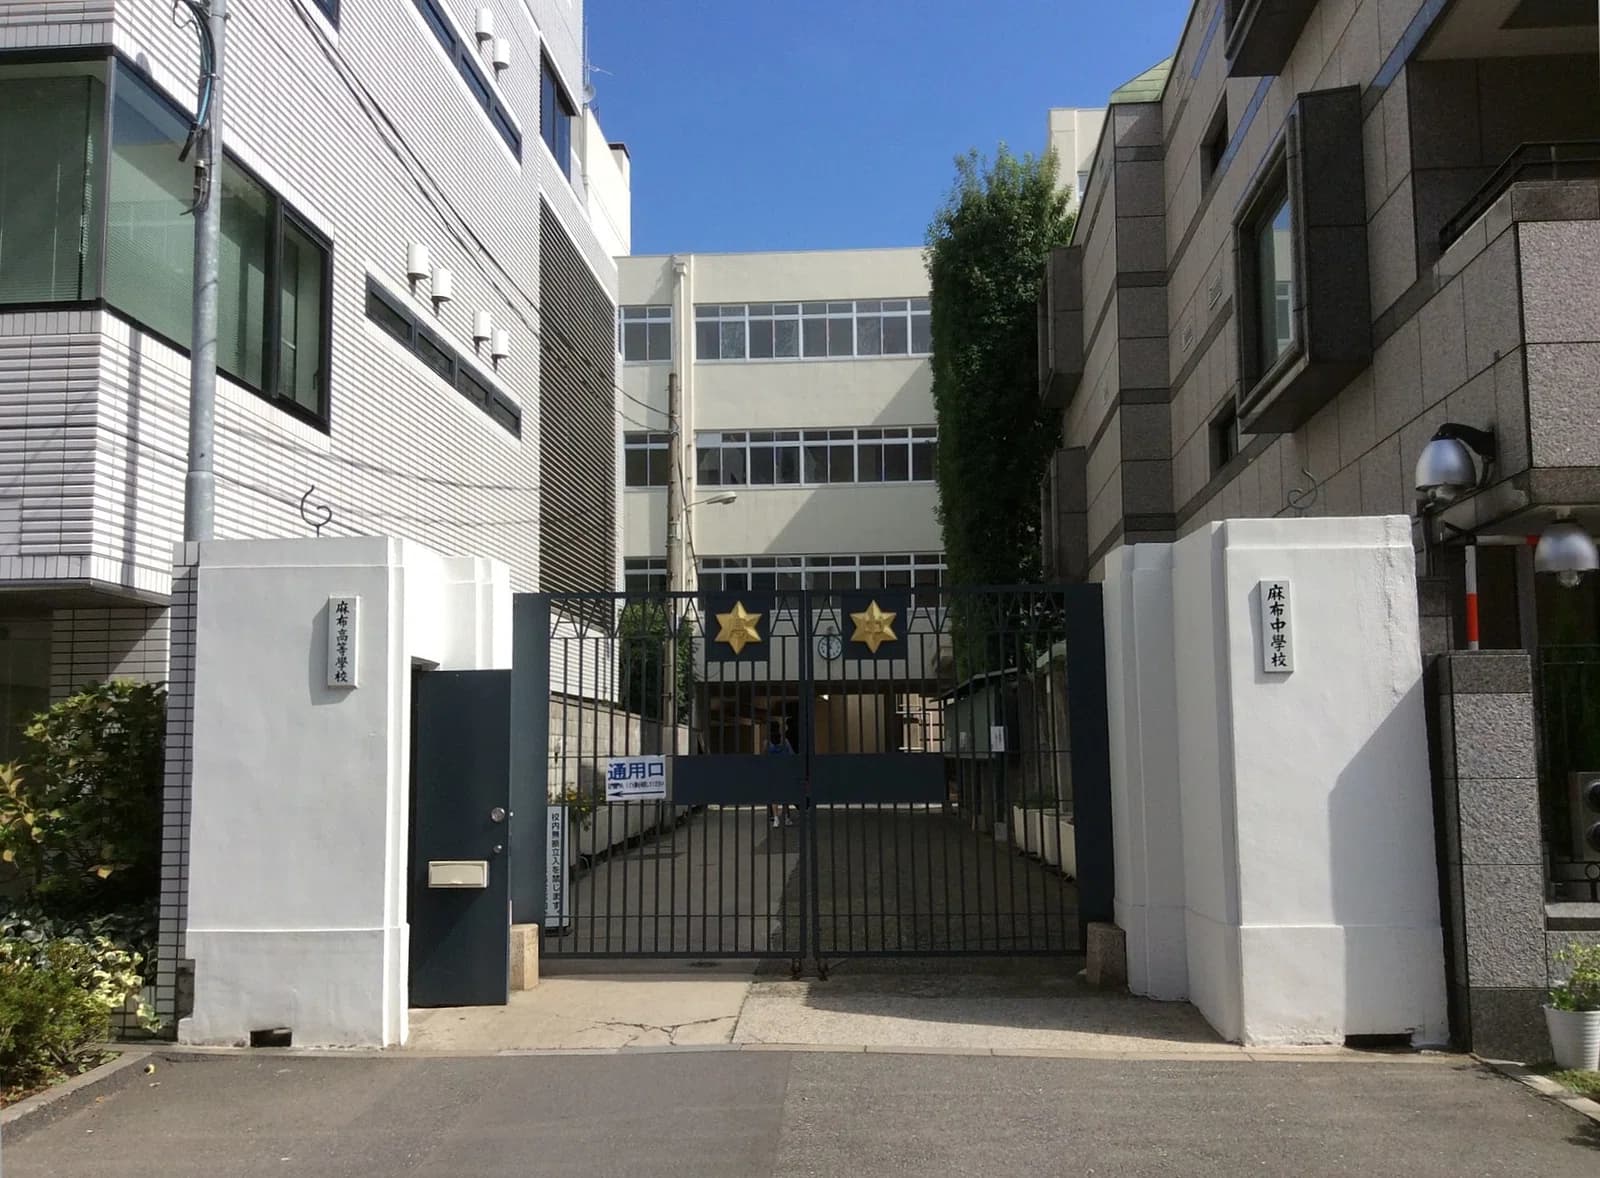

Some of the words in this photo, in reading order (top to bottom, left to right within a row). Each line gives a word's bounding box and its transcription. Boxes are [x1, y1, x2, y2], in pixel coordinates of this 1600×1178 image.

[334, 600, 350, 683] 麻布高等學校
[1267, 583, 1289, 668] 麻布中學校
[608, 762, 664, 781] 通用口
